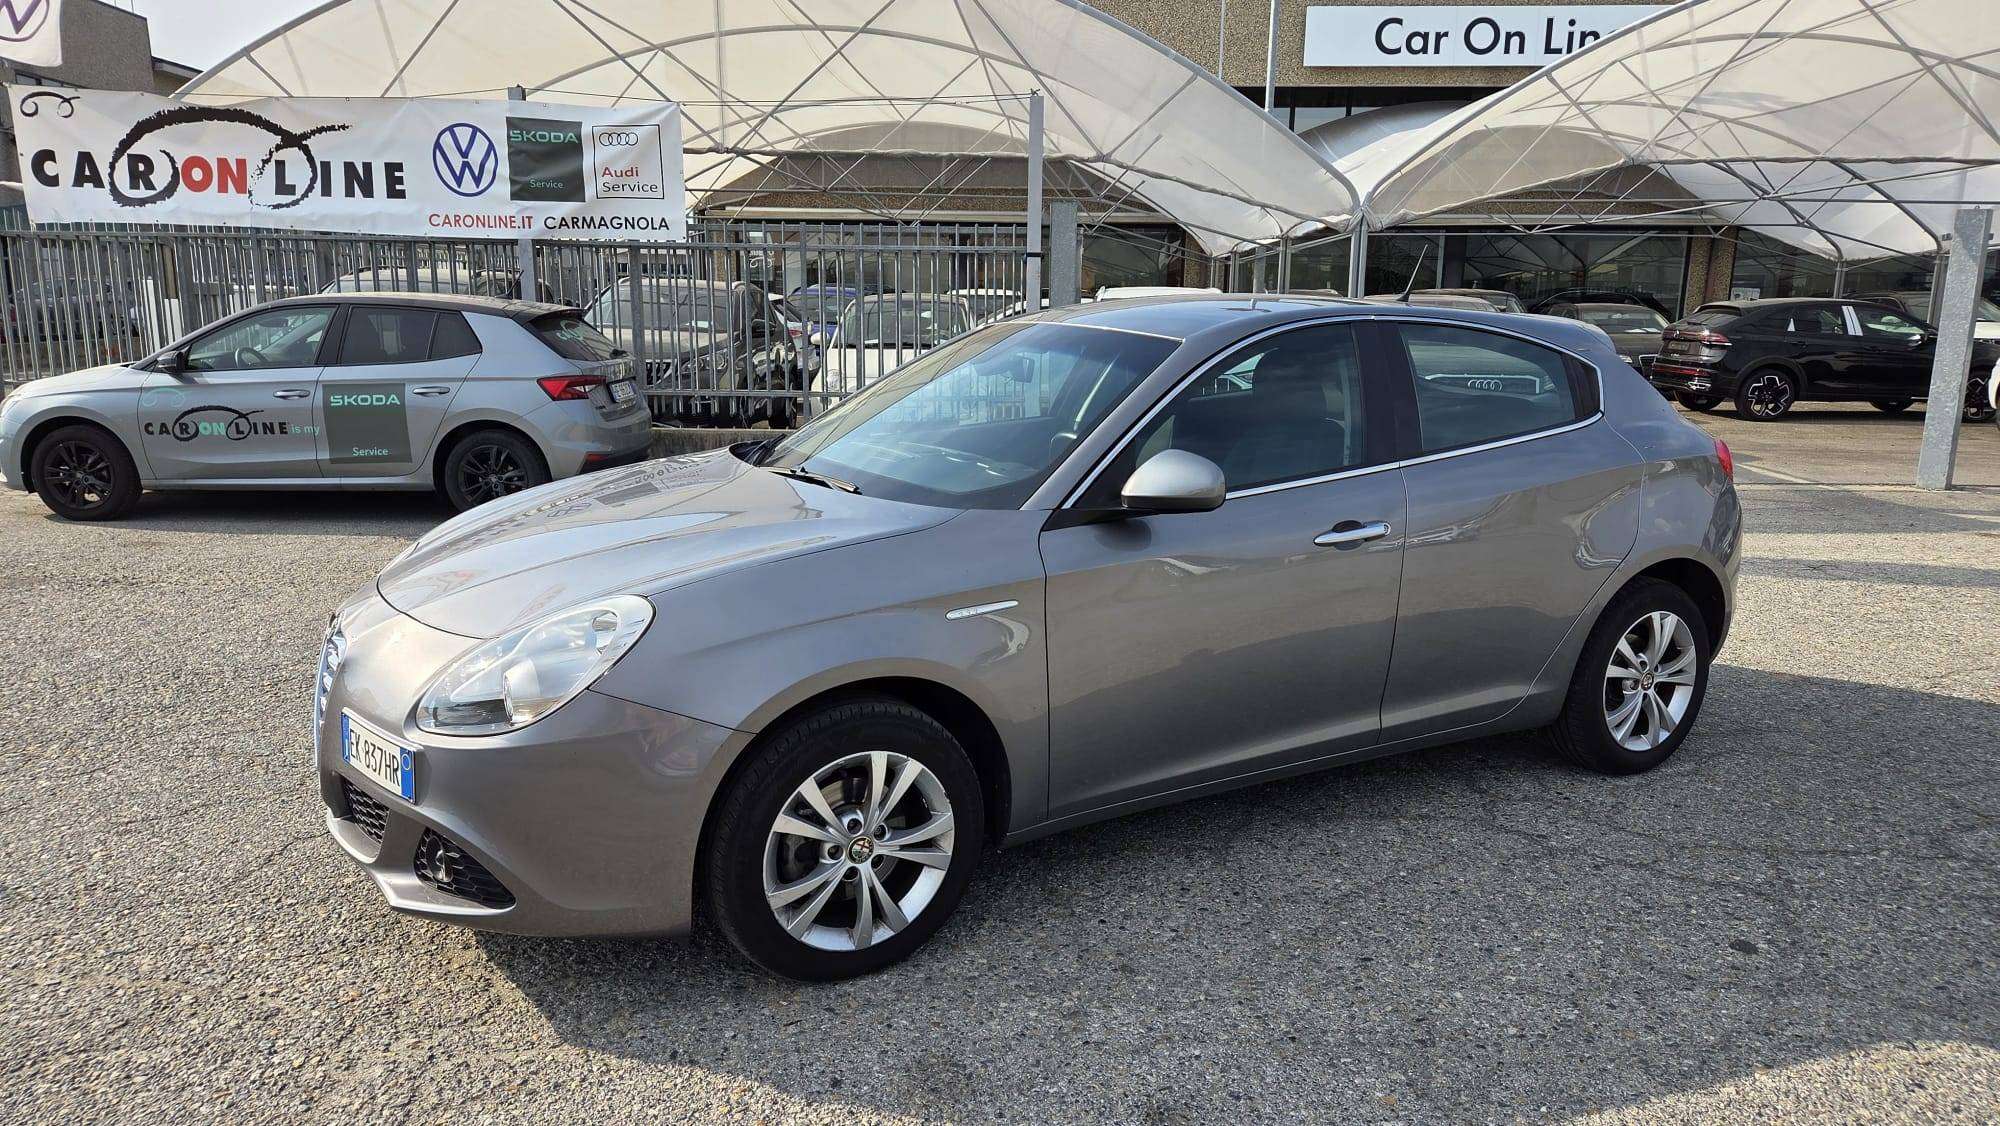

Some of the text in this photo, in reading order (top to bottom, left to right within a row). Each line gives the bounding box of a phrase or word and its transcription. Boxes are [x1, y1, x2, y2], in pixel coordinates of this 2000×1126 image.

[1375, 17, 1617, 55] Car On Lin
[601, 166, 639, 178] Audi
[530, 179, 564, 189] Service
[602, 181, 659, 194] Service
[429, 213, 670, 231] CARONLINE.IT CARMAGNOLA
[291, 424, 301, 435] is
[304, 425, 320, 436] my
[352, 446, 389, 457] Service
